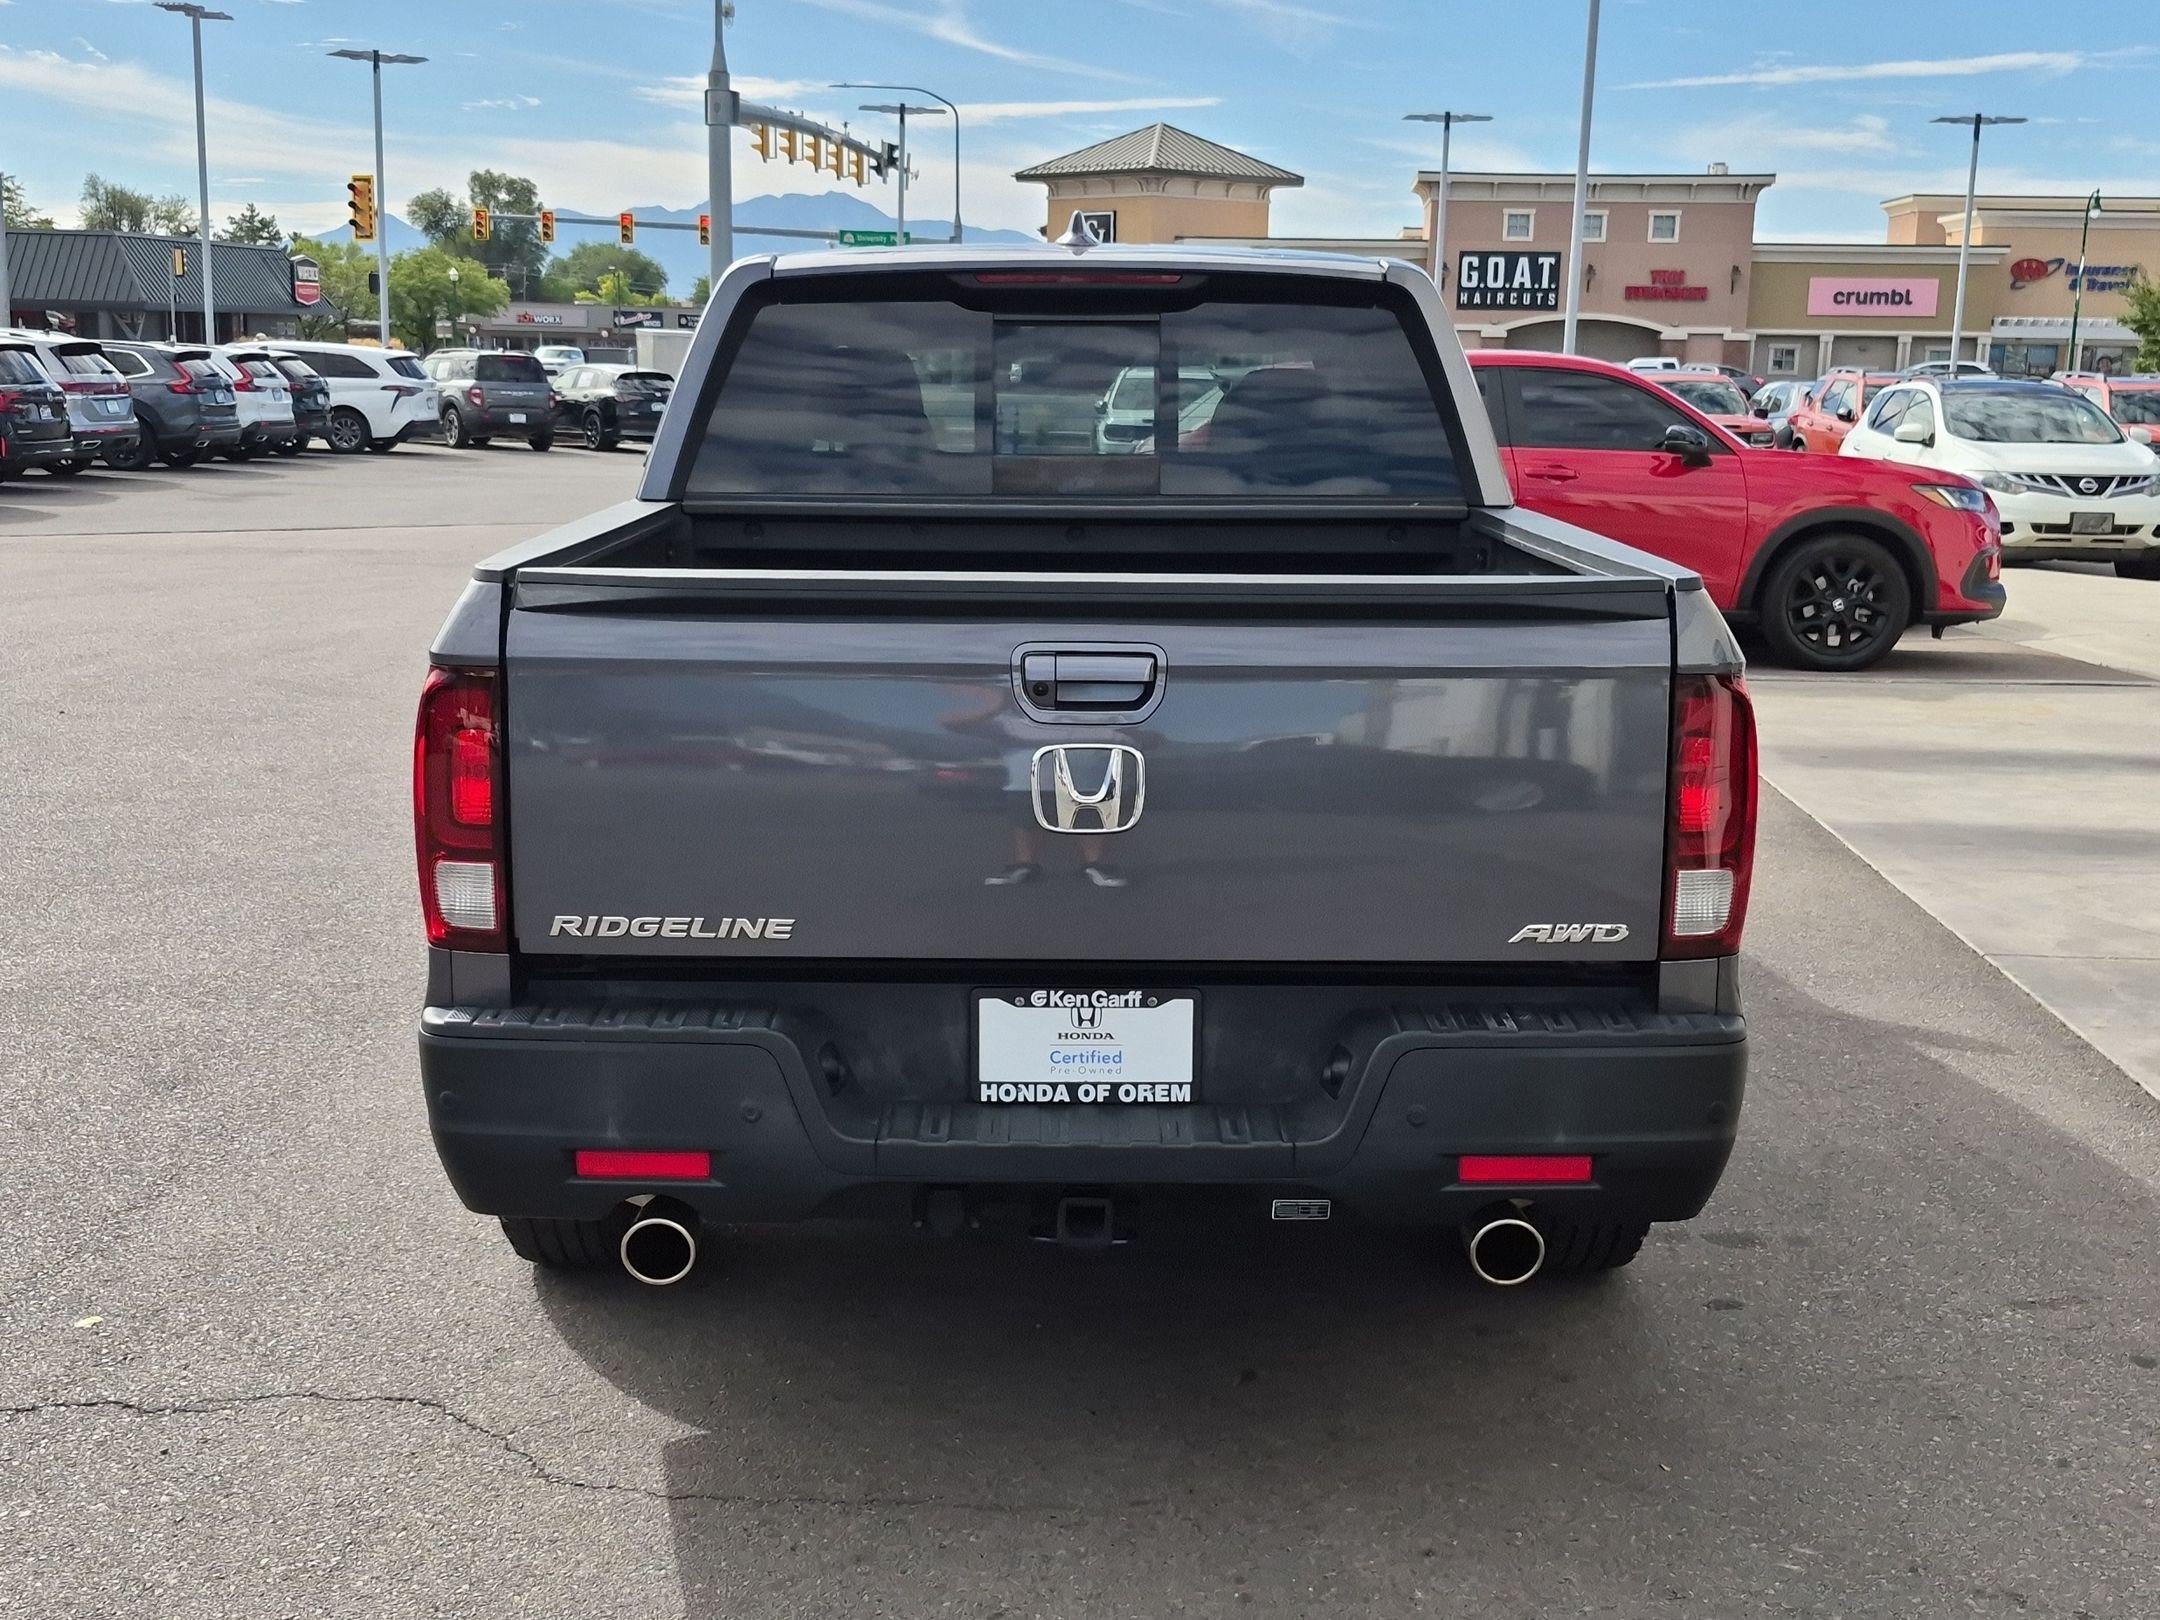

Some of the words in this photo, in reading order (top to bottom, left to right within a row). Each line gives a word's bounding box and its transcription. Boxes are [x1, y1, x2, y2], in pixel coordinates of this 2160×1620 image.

[1460, 256, 1556, 289] G.O.A.T.
[1460, 291, 1556, 306] HAIRCUTS
[1832, 288, 1913, 307] crumbl
[549, 915, 796, 940] RIDGELINE
[1507, 923, 1630, 943] AWD
[1049, 990, 1089, 1008] Ken
[1091, 990, 1143, 1008] Garff
[1057, 1032, 1115, 1040] HONDA
[1050, 1050, 1122, 1064] Certified
[980, 1083, 1071, 1102] HONDA
[1077, 1084, 1112, 1102] OF
[1117, 1084, 1191, 1102] OREM
